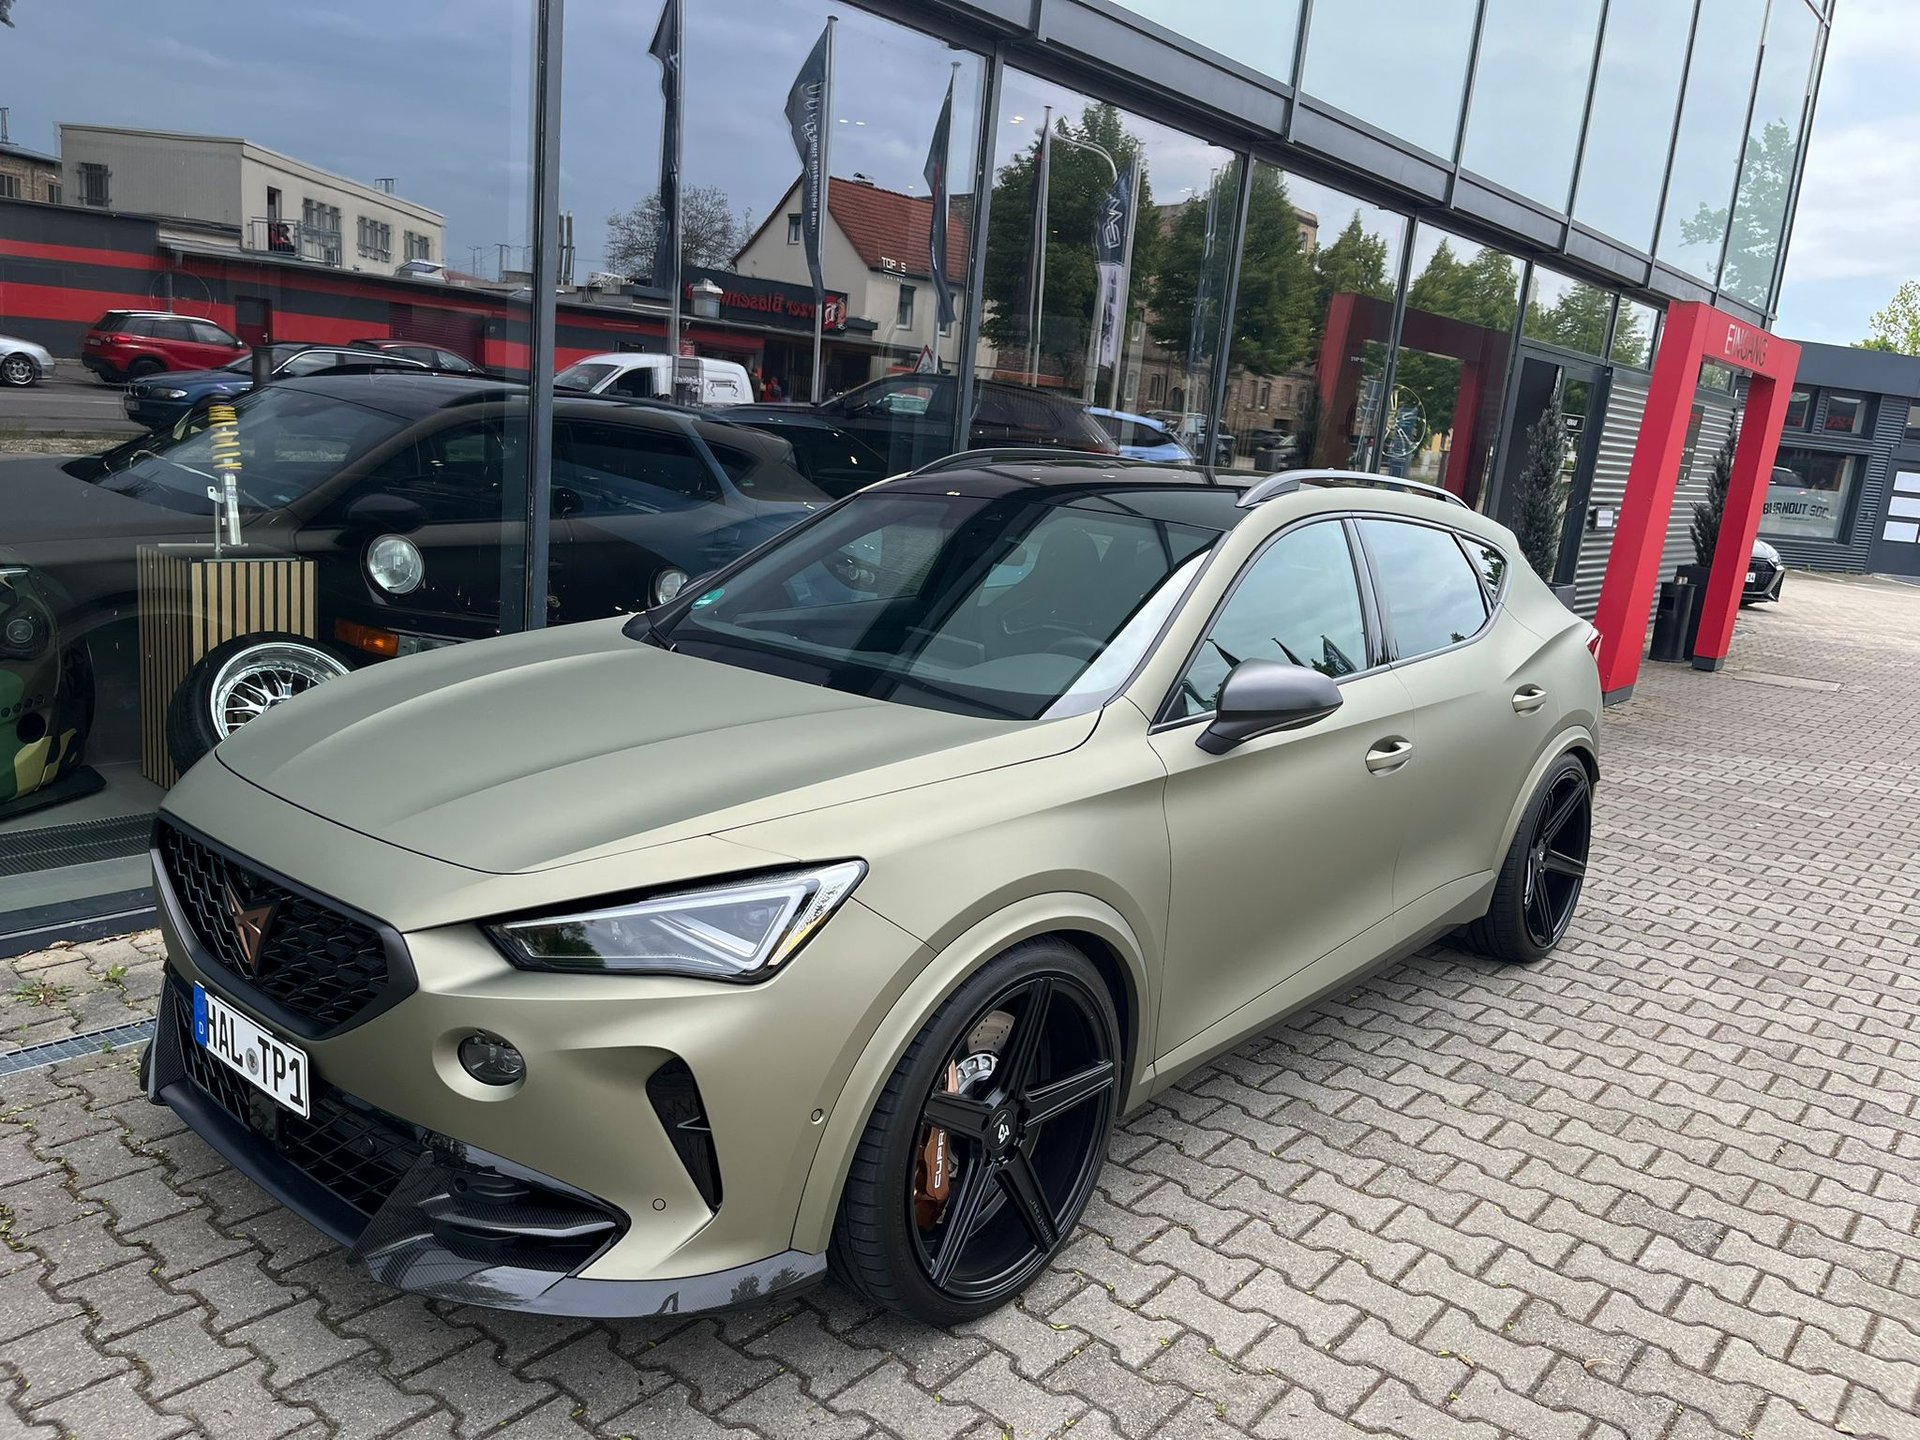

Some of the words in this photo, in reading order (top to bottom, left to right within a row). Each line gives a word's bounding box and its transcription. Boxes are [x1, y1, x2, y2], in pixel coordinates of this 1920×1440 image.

[881, 256, 897, 270] TOP
[1724, 323, 1769, 367] EINGANG
[1762, 501, 1808, 515] BURNOUT
[198, 1020, 205, 1035] D
[205, 999, 243, 1068] HAL
[934, 1129, 946, 1189] CUPR
